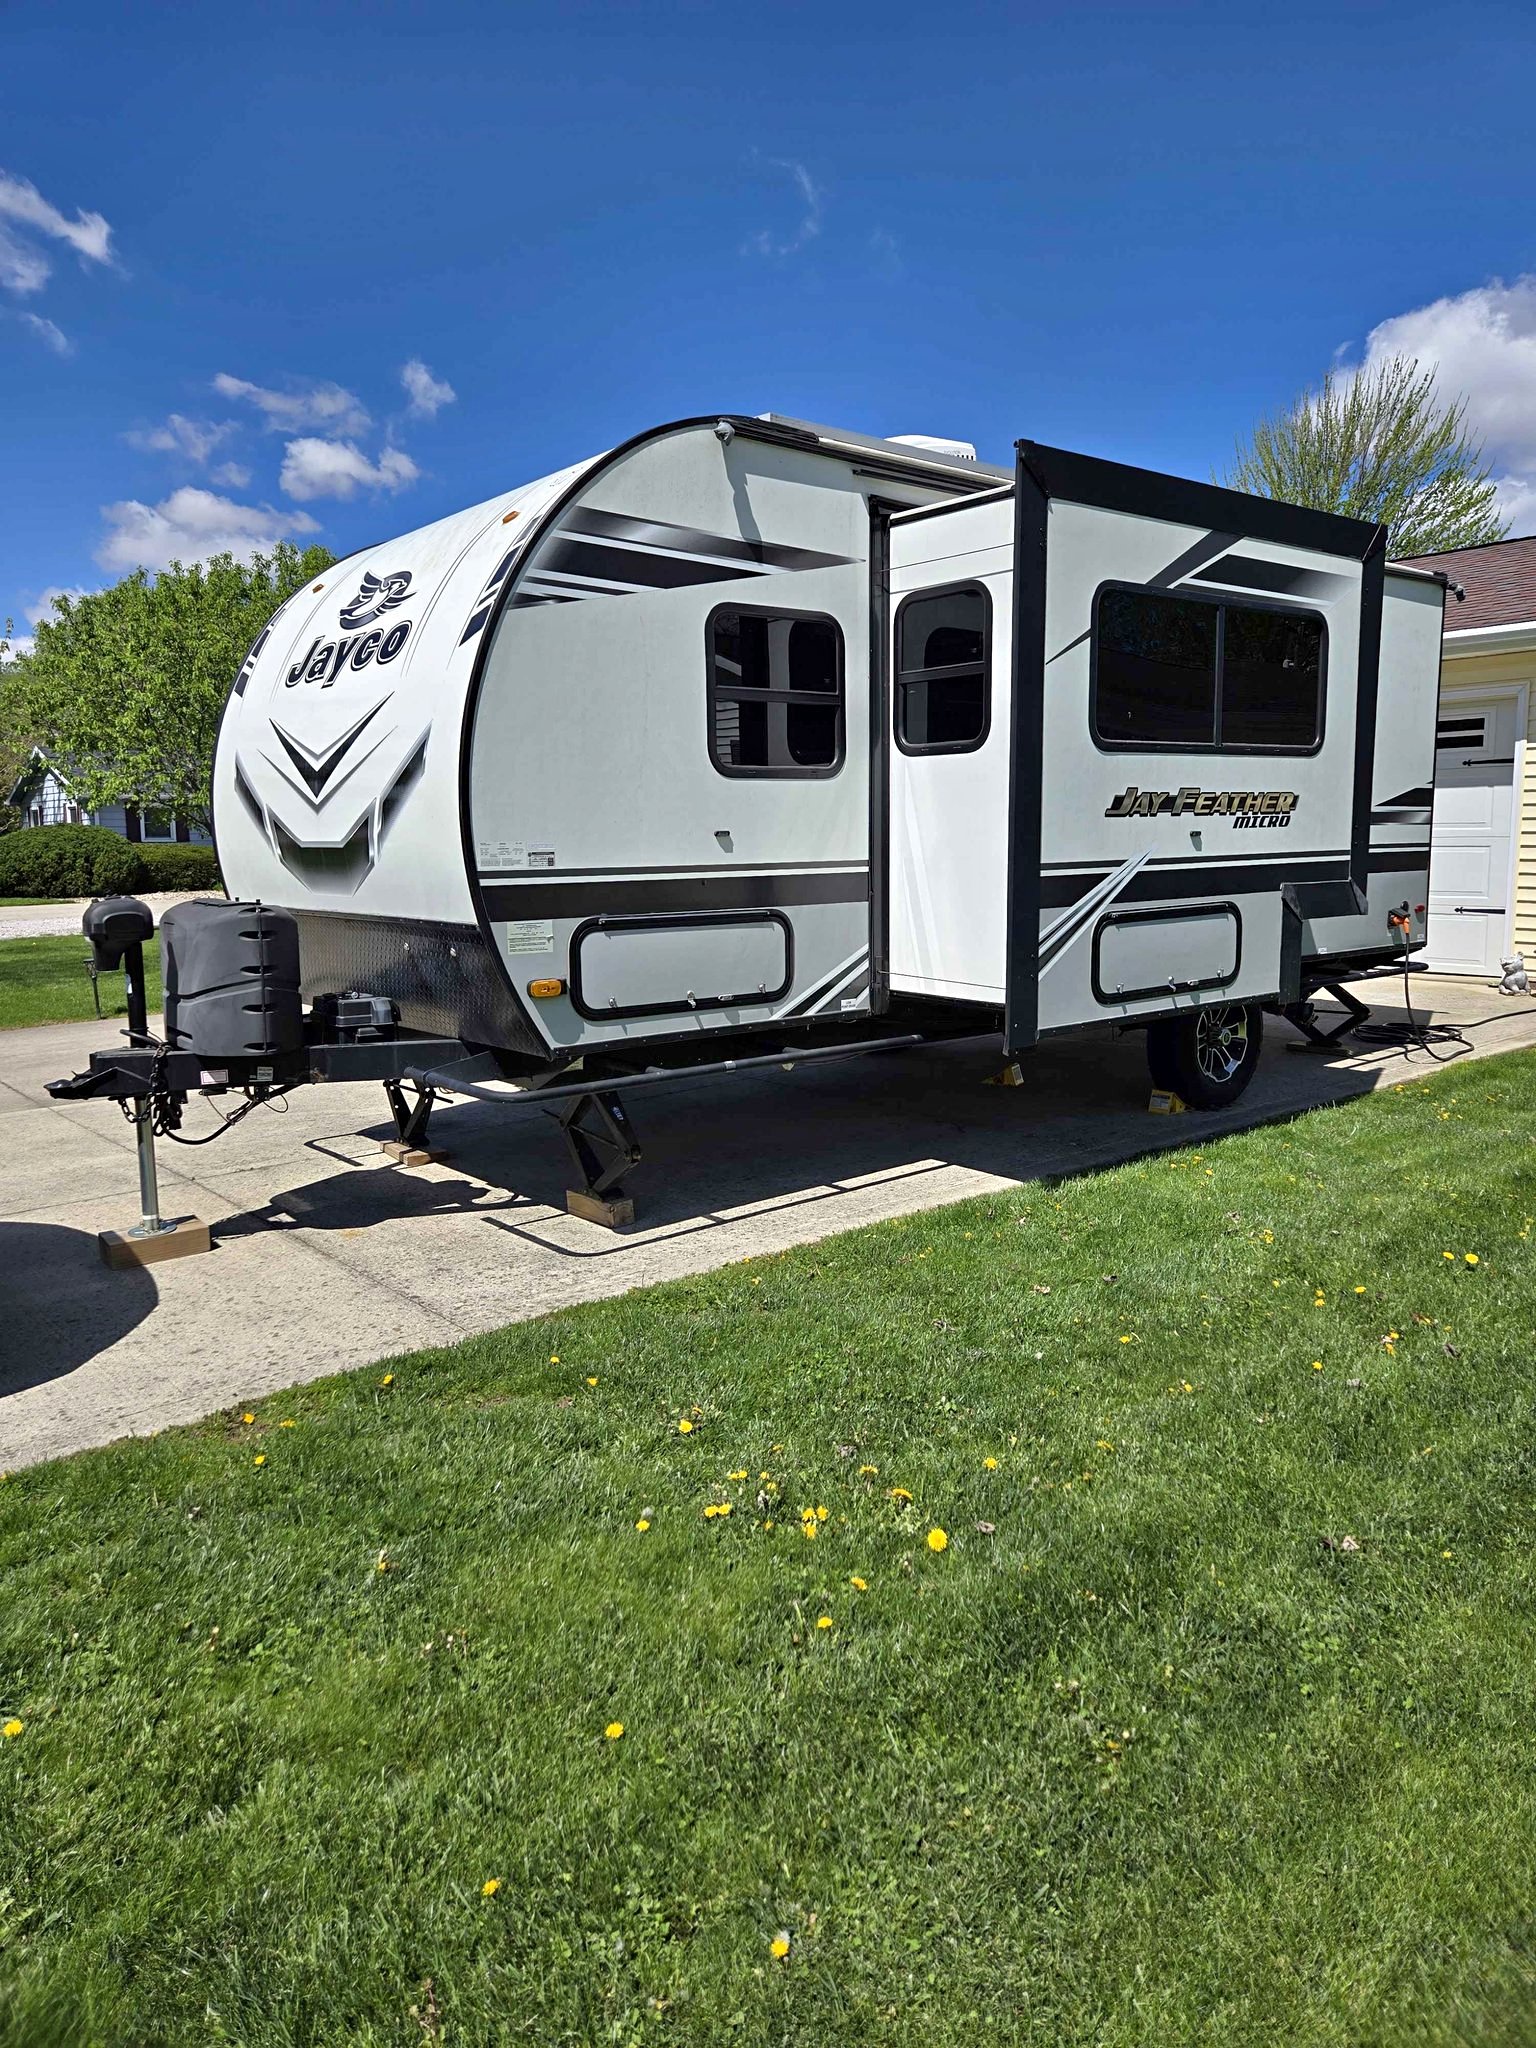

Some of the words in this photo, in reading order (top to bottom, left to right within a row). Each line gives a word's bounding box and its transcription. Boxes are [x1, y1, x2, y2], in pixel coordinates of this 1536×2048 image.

[285, 620, 412, 689] Jayco
[1105, 787, 1169, 817] JAY
[1171, 787, 1297, 816] FEATHER
[1233, 816, 1291, 828] MICRO
